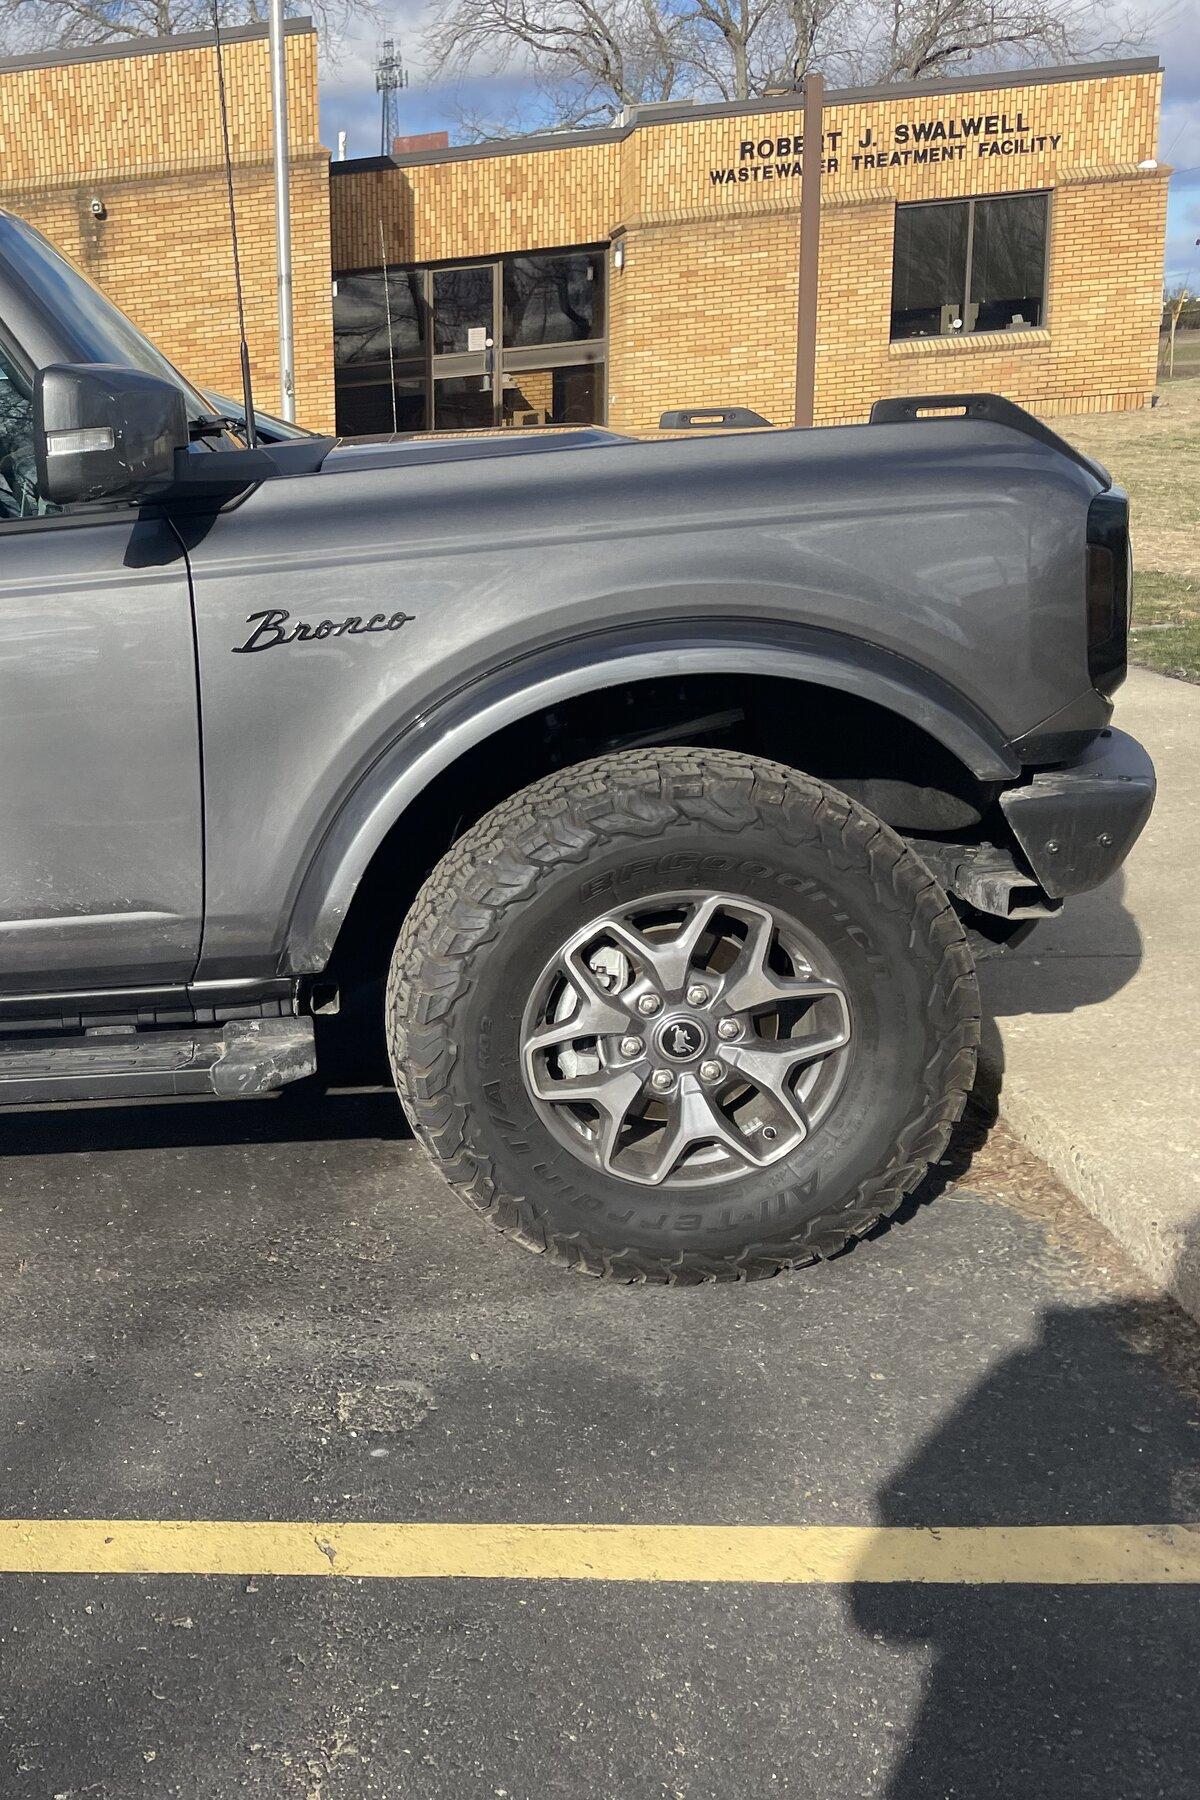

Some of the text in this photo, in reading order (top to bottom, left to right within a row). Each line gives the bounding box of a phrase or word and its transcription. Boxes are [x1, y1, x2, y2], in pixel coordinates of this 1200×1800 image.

[709, 135, 1061, 186] WASTEWAR TREATMENT FACILITY
[740, 113, 1030, 161] ROBET J. SWALWELL
[230, 608, 416, 654] Bronco
